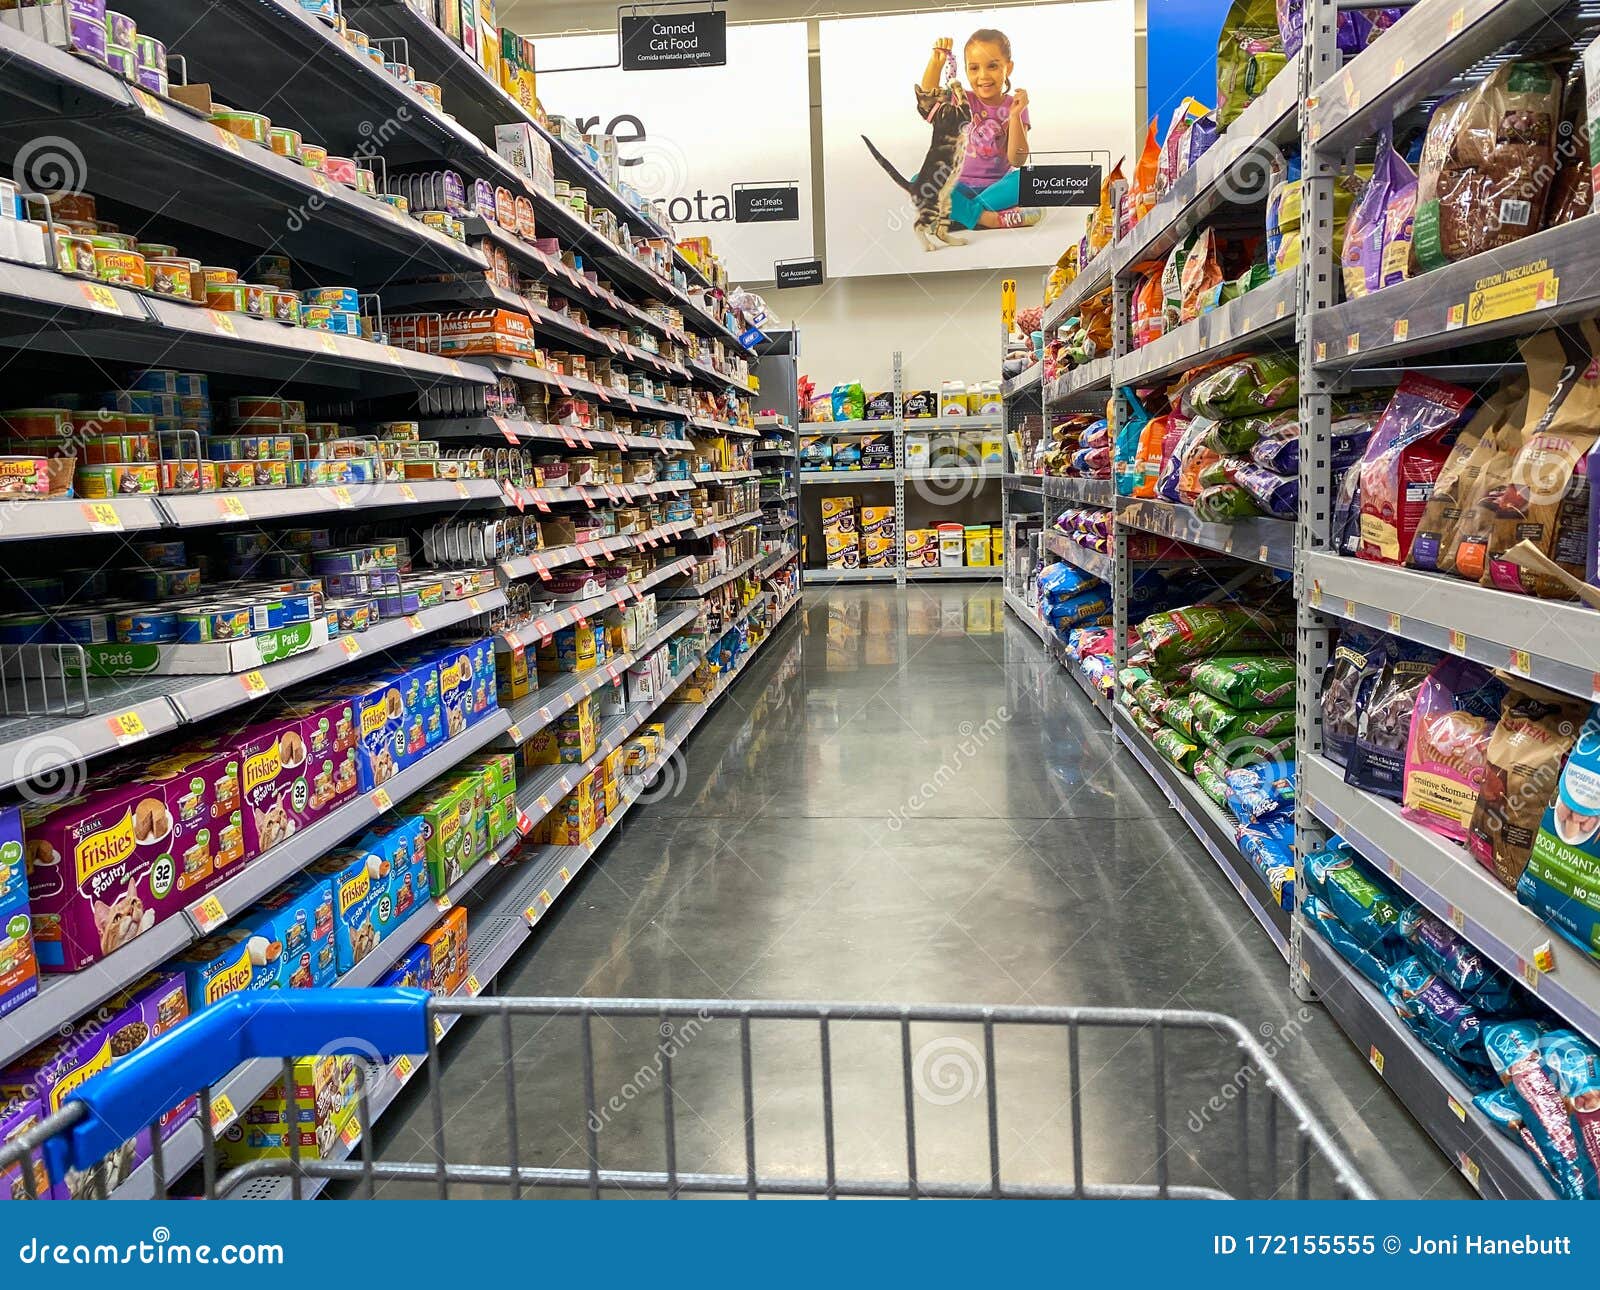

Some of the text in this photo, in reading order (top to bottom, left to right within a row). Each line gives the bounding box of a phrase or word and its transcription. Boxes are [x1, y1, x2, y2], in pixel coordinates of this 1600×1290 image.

[652, 21, 695, 36] Canned
[649, 37, 698, 51] Cat Food
[660, 53, 682, 61] enlatada
[1032, 177, 1089, 189] Dry Cat Food
[750, 198, 783, 207] Cat Treats
[105, 256, 134, 268] Friskies
[790, 268, 818, 277] Accessories
[1475, 273, 1502, 290] CAUTION
[1505, 257, 1548, 280] PRECAUCIÓN
[282, 629, 300, 647] Paté
[100, 650, 133, 665] Paté
[363, 707, 387, 731] Friskies
[396, 733, 404, 745] 32
[246, 756, 280, 787] Friskies
[255, 781, 276, 807] Poultry
[294, 785, 305, 799] 32
[1412, 775, 1478, 802] ensitive Stomach
[78, 819, 102, 836] PURINA
[81, 829, 133, 874] Friskies
[92, 862, 127, 898] Poultry
[155, 864, 171, 882] 32
[155, 880, 169, 889] CANS
[1573, 885, 1587, 899] NO
[341, 878, 370, 908] Friskies
[379, 900, 391, 914] 32
[1381, 904, 1393, 918] 16
[12, 922, 26, 932] Paté
[207, 960, 226, 976] PURINA
[210, 966, 250, 1004] Friskies
